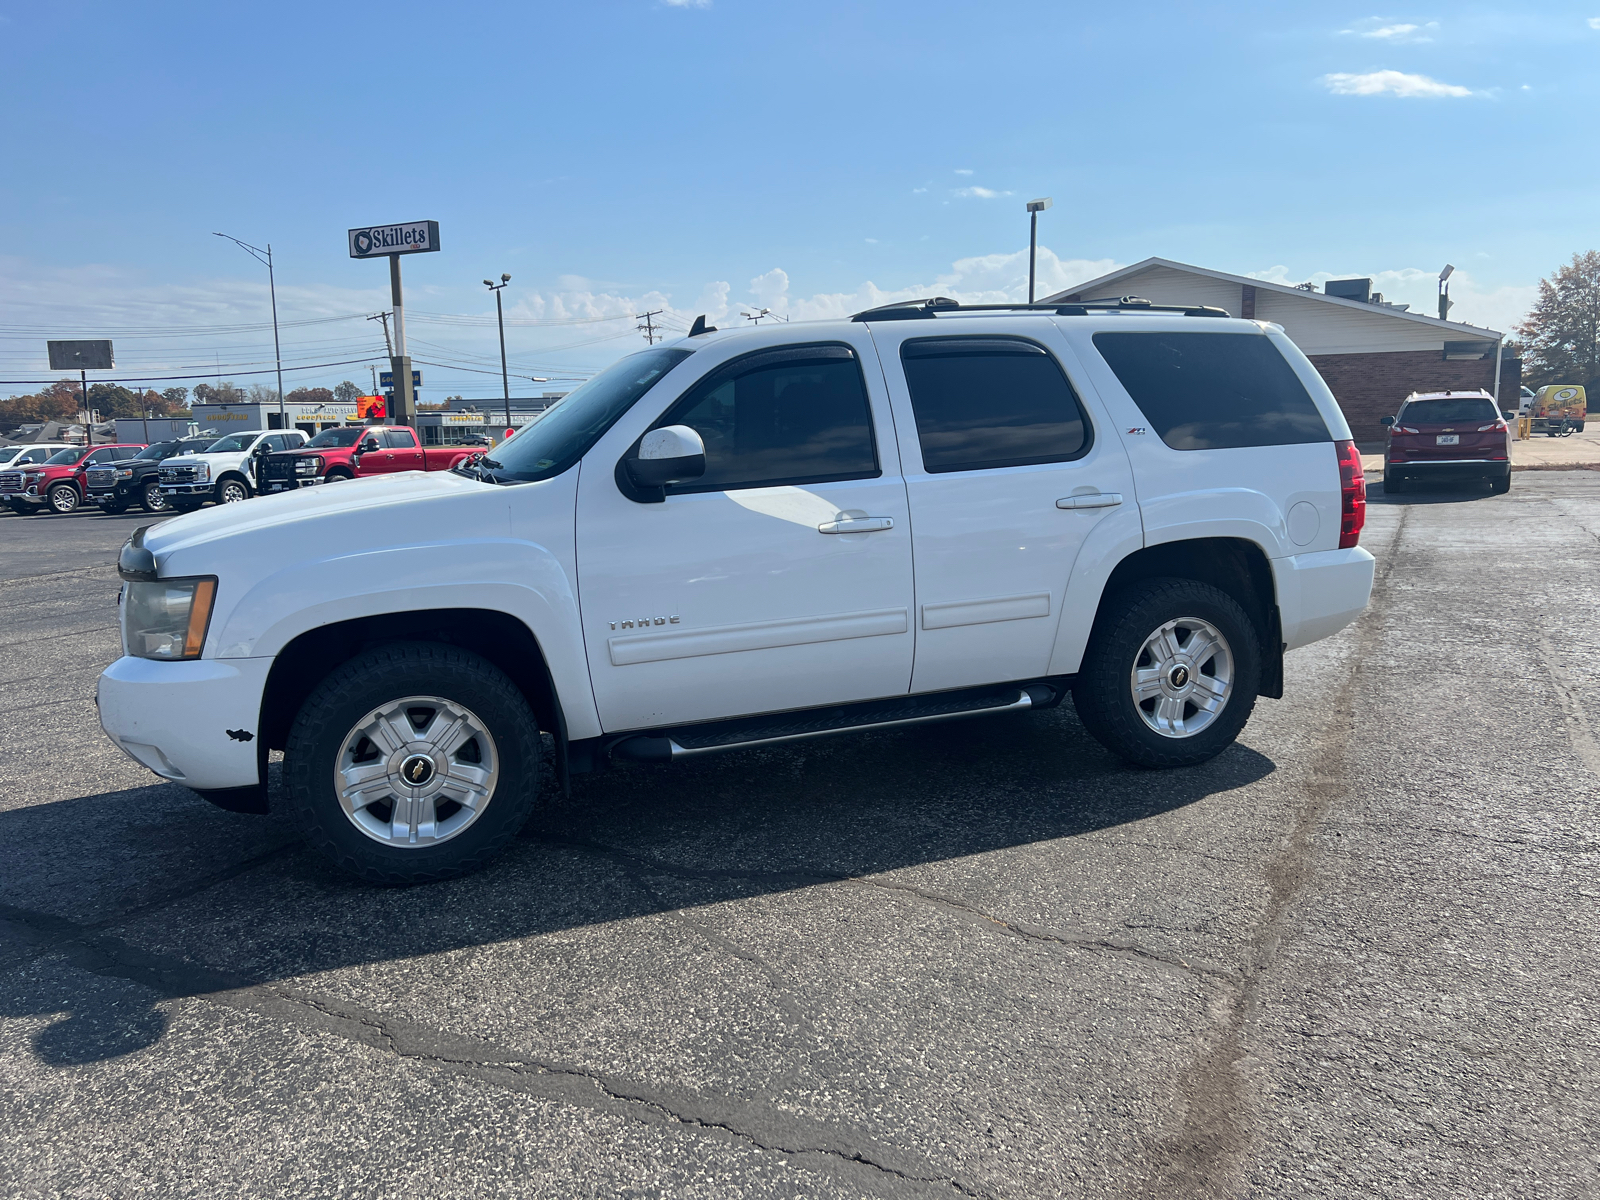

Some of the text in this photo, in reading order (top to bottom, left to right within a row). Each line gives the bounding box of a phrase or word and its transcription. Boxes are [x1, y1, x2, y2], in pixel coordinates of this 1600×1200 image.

[372, 227, 426, 248] Skillets
[206, 411, 248, 422] GOODYEAR
[296, 413, 336, 421] GOODYEAR
[607, 614, 680, 630] TAHOE
[354, 846, 454, 869] NEXEN
